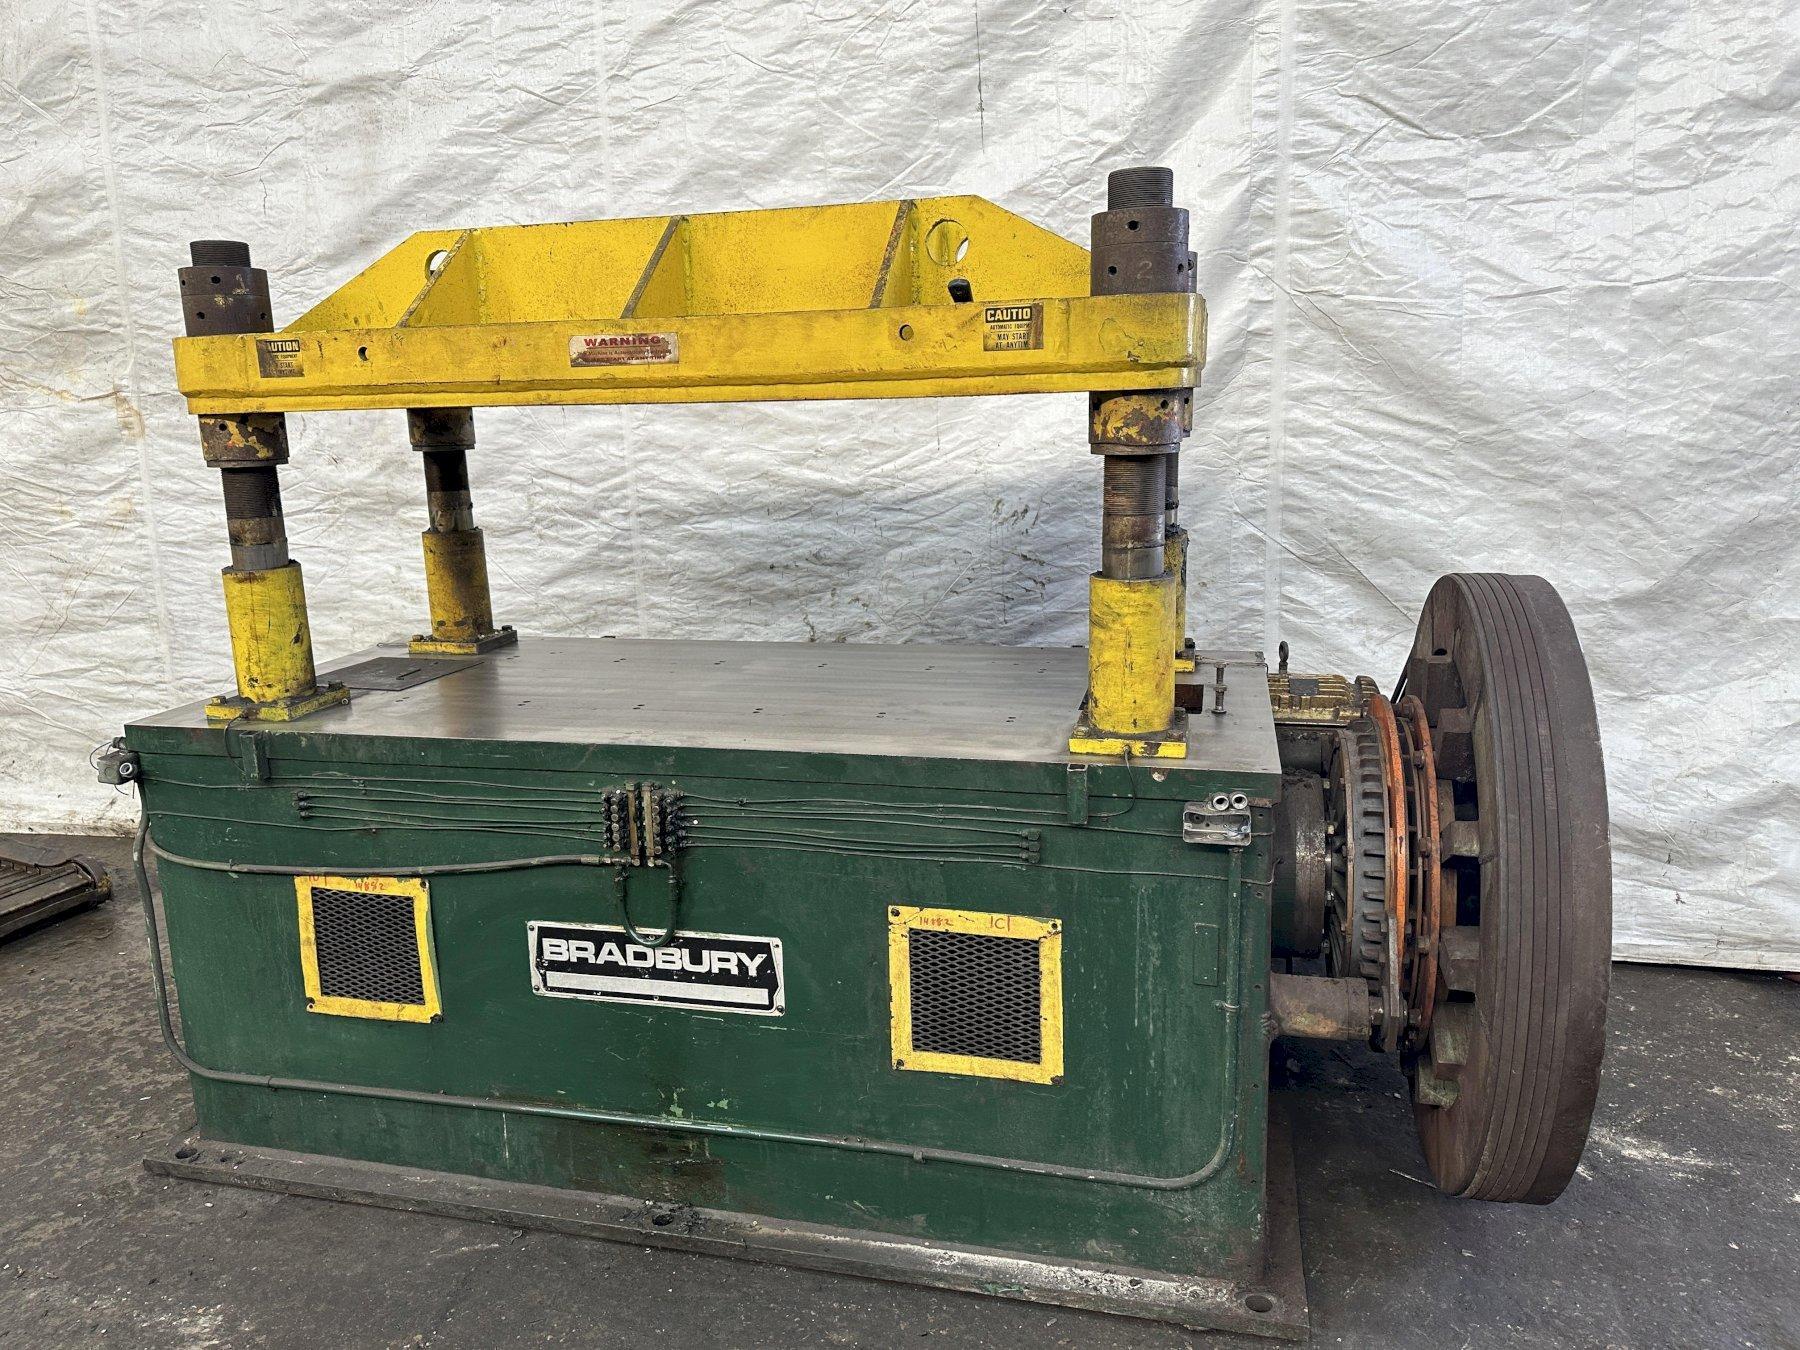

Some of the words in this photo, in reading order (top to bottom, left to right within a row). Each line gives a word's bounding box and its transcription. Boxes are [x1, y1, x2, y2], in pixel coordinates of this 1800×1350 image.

[987, 308, 1031, 321] CAUTIO
[266, 341, 299, 351] AUTION
[584, 336, 661, 346] WARNING
[541, 937, 767, 977] BRADBURY
